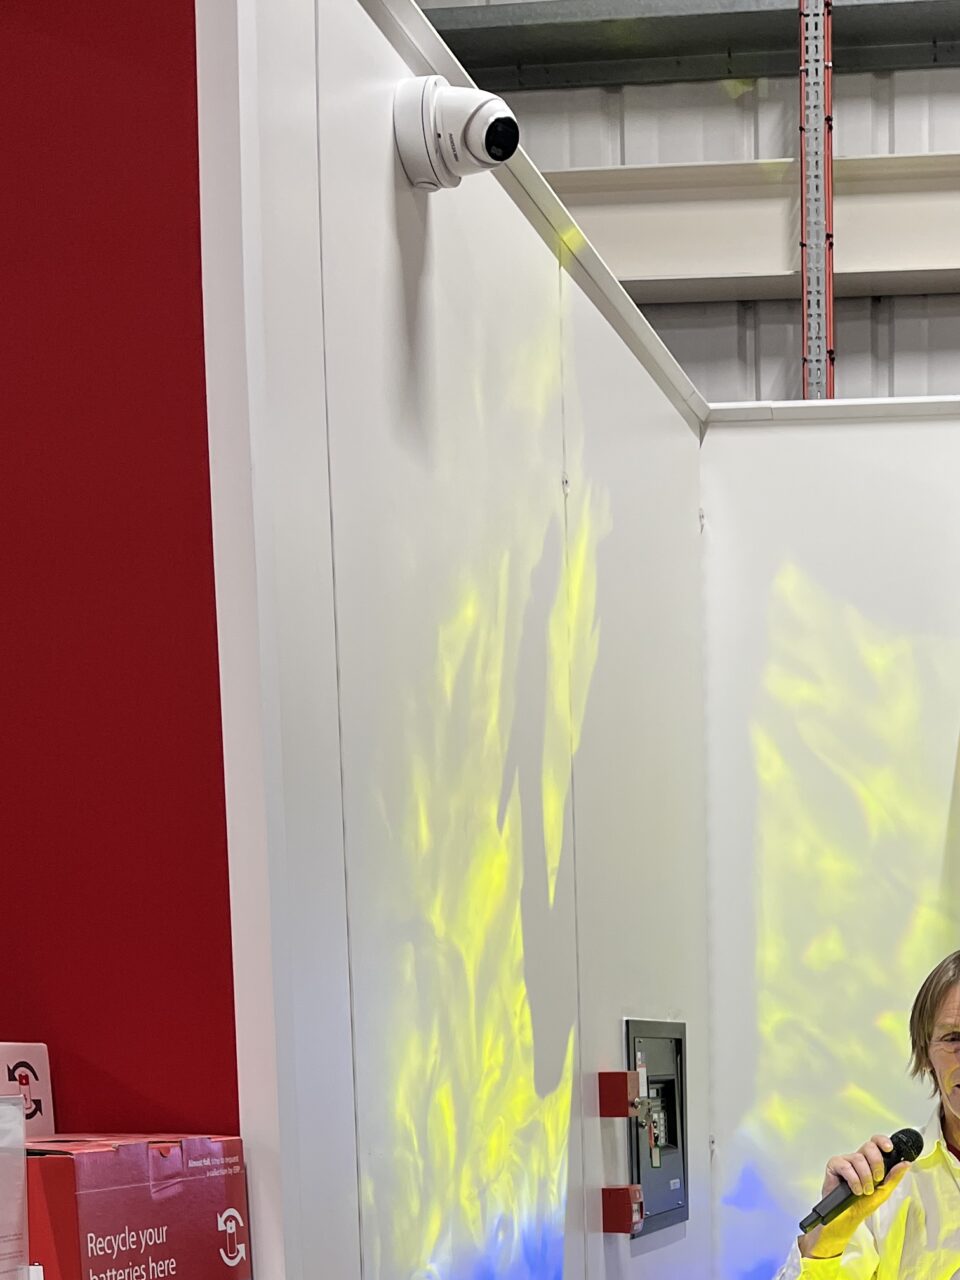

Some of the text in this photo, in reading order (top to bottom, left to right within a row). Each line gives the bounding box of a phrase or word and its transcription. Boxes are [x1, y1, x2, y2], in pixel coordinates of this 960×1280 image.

[87, 1225, 168, 1259] Recycle your
[149, 1256, 176, 1279] here
